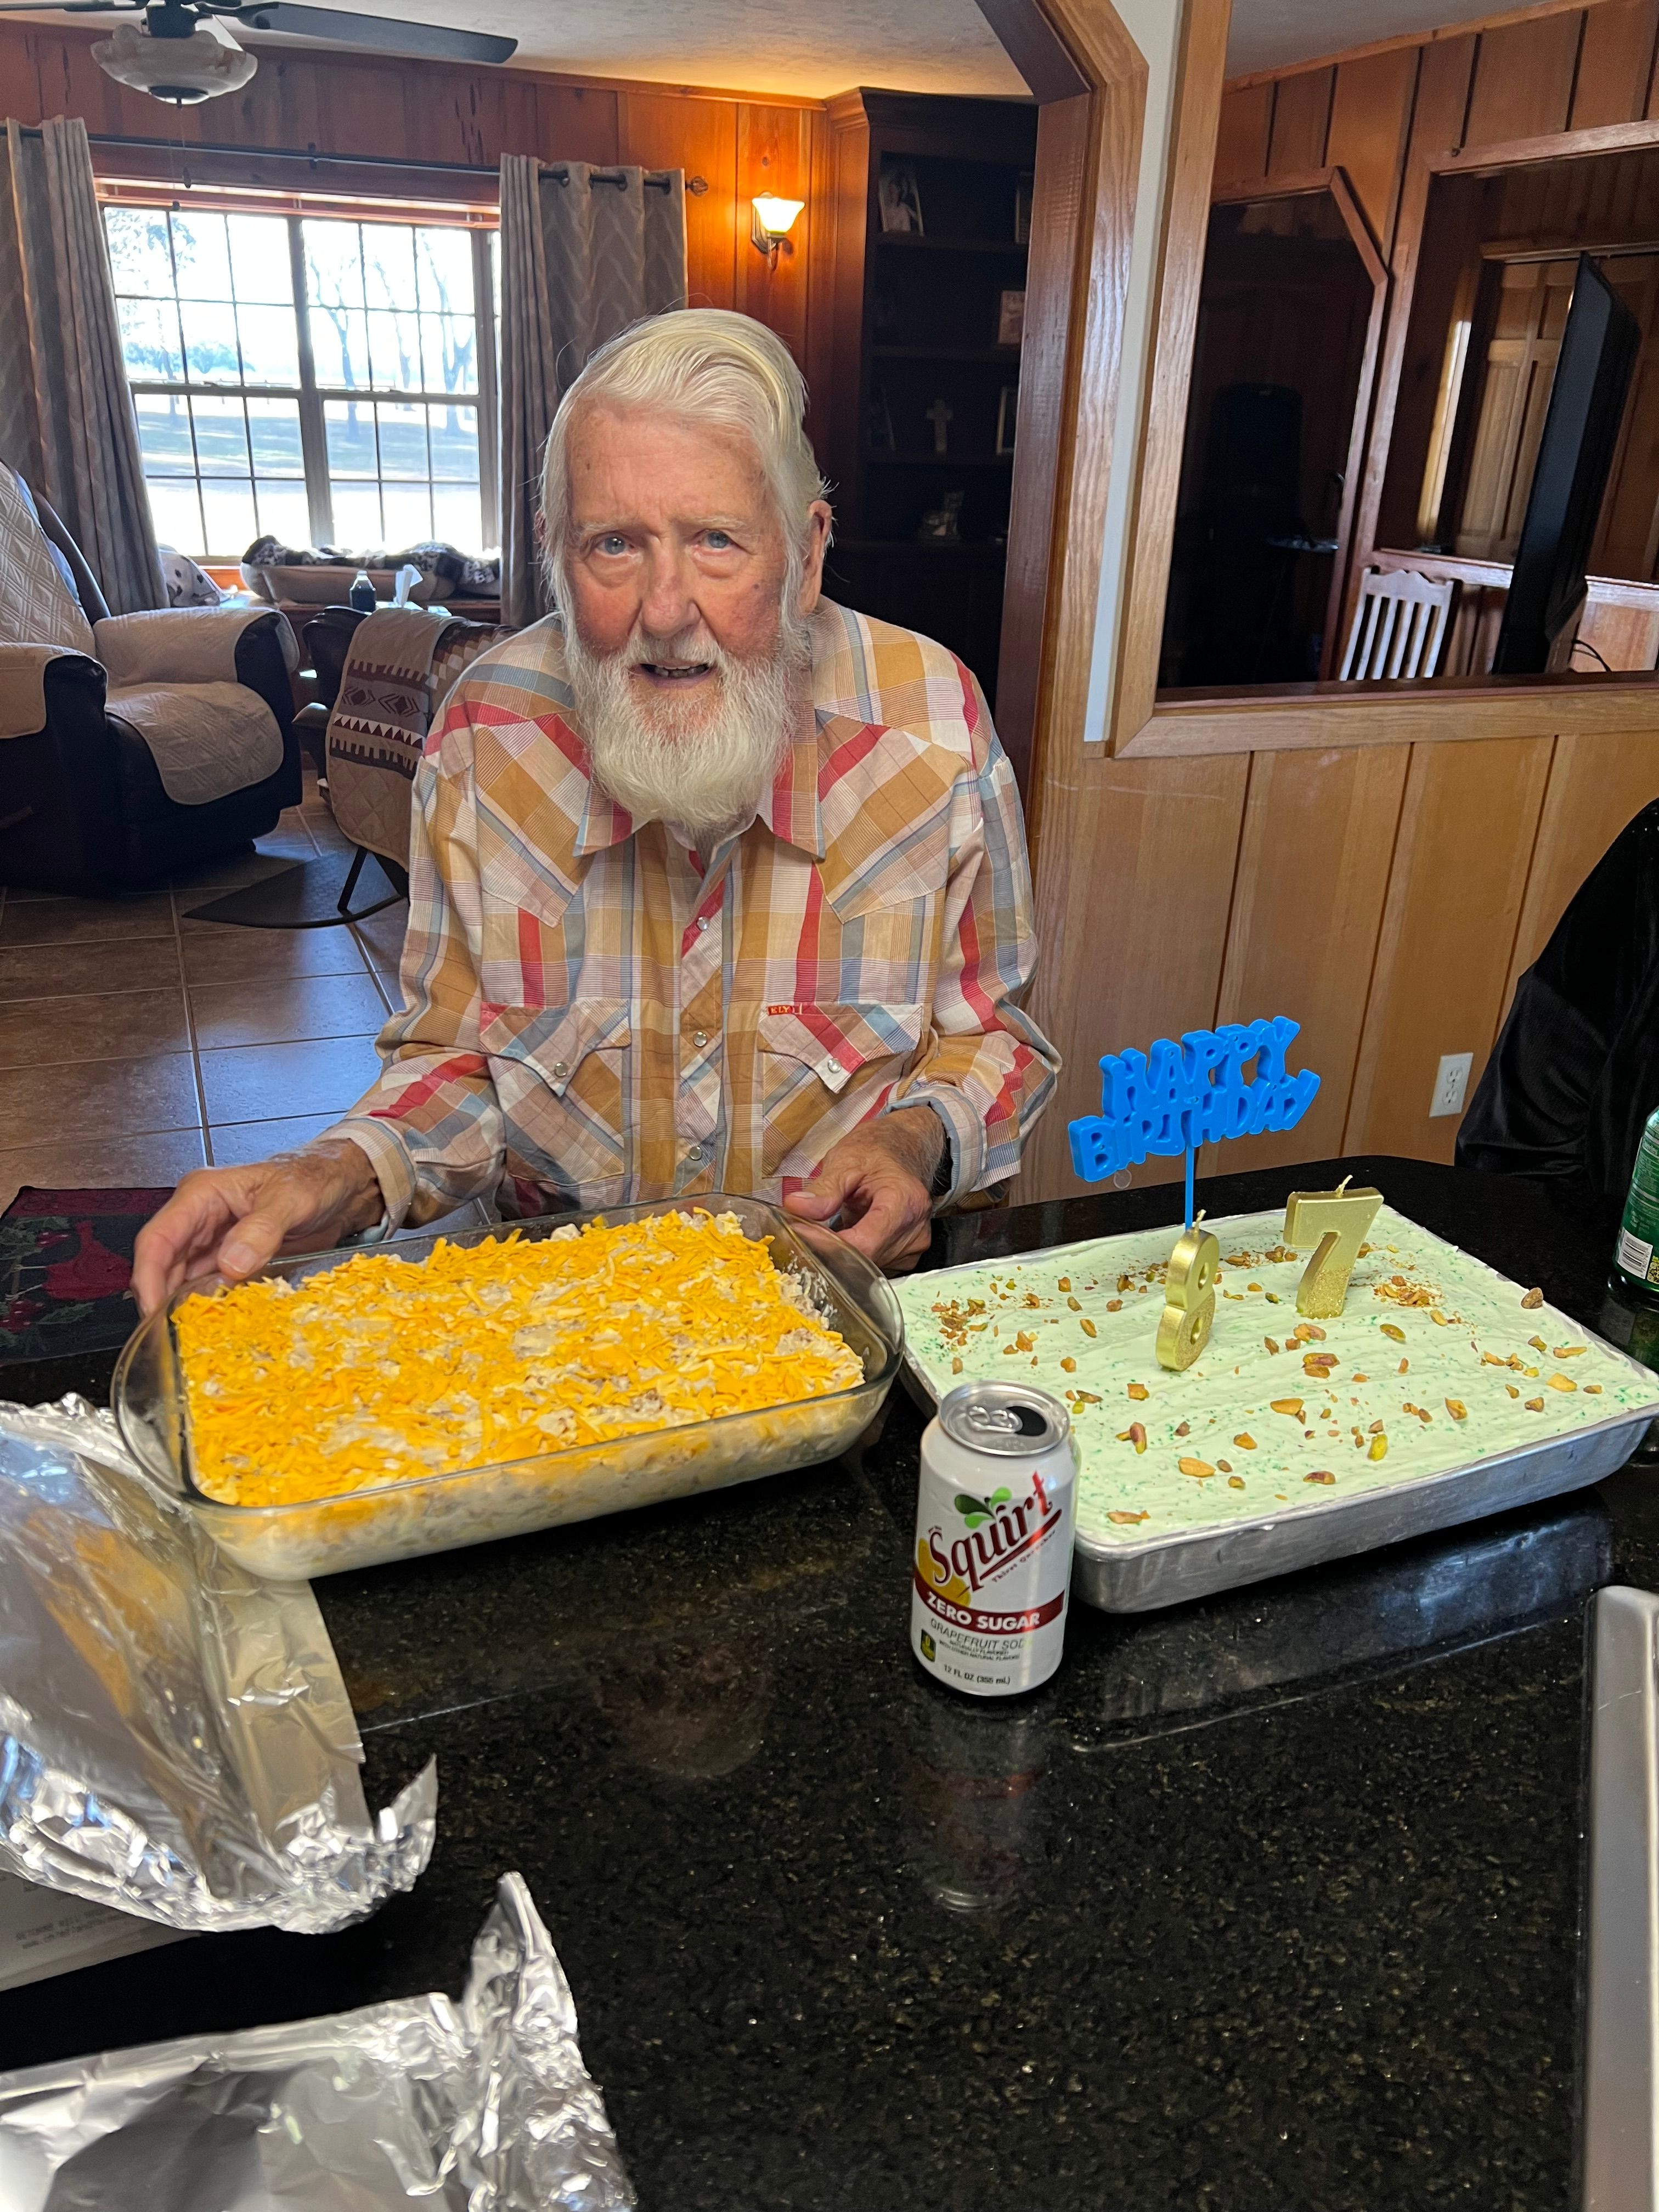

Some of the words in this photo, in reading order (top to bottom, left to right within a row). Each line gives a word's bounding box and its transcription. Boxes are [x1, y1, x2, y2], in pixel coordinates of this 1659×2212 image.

[770, 1006, 791, 1014] ELY
[1099, 1015, 1300, 1118] HAPPY
[1068, 1069, 1321, 1182] BIRTHDAY
[928, 1470, 1053, 1592] Squirt
[927, 1592, 972, 1626] ZERO
[977, 1612, 1041, 1631] SUGAR
[930, 1618, 1000, 1650] GRAPEFRUIT
[1001, 1637, 1029, 1651] SOD
[944, 1664, 952, 1673] 12
[953, 1668, 962, 1678] FL
[964, 1673, 974, 1682] OZ
